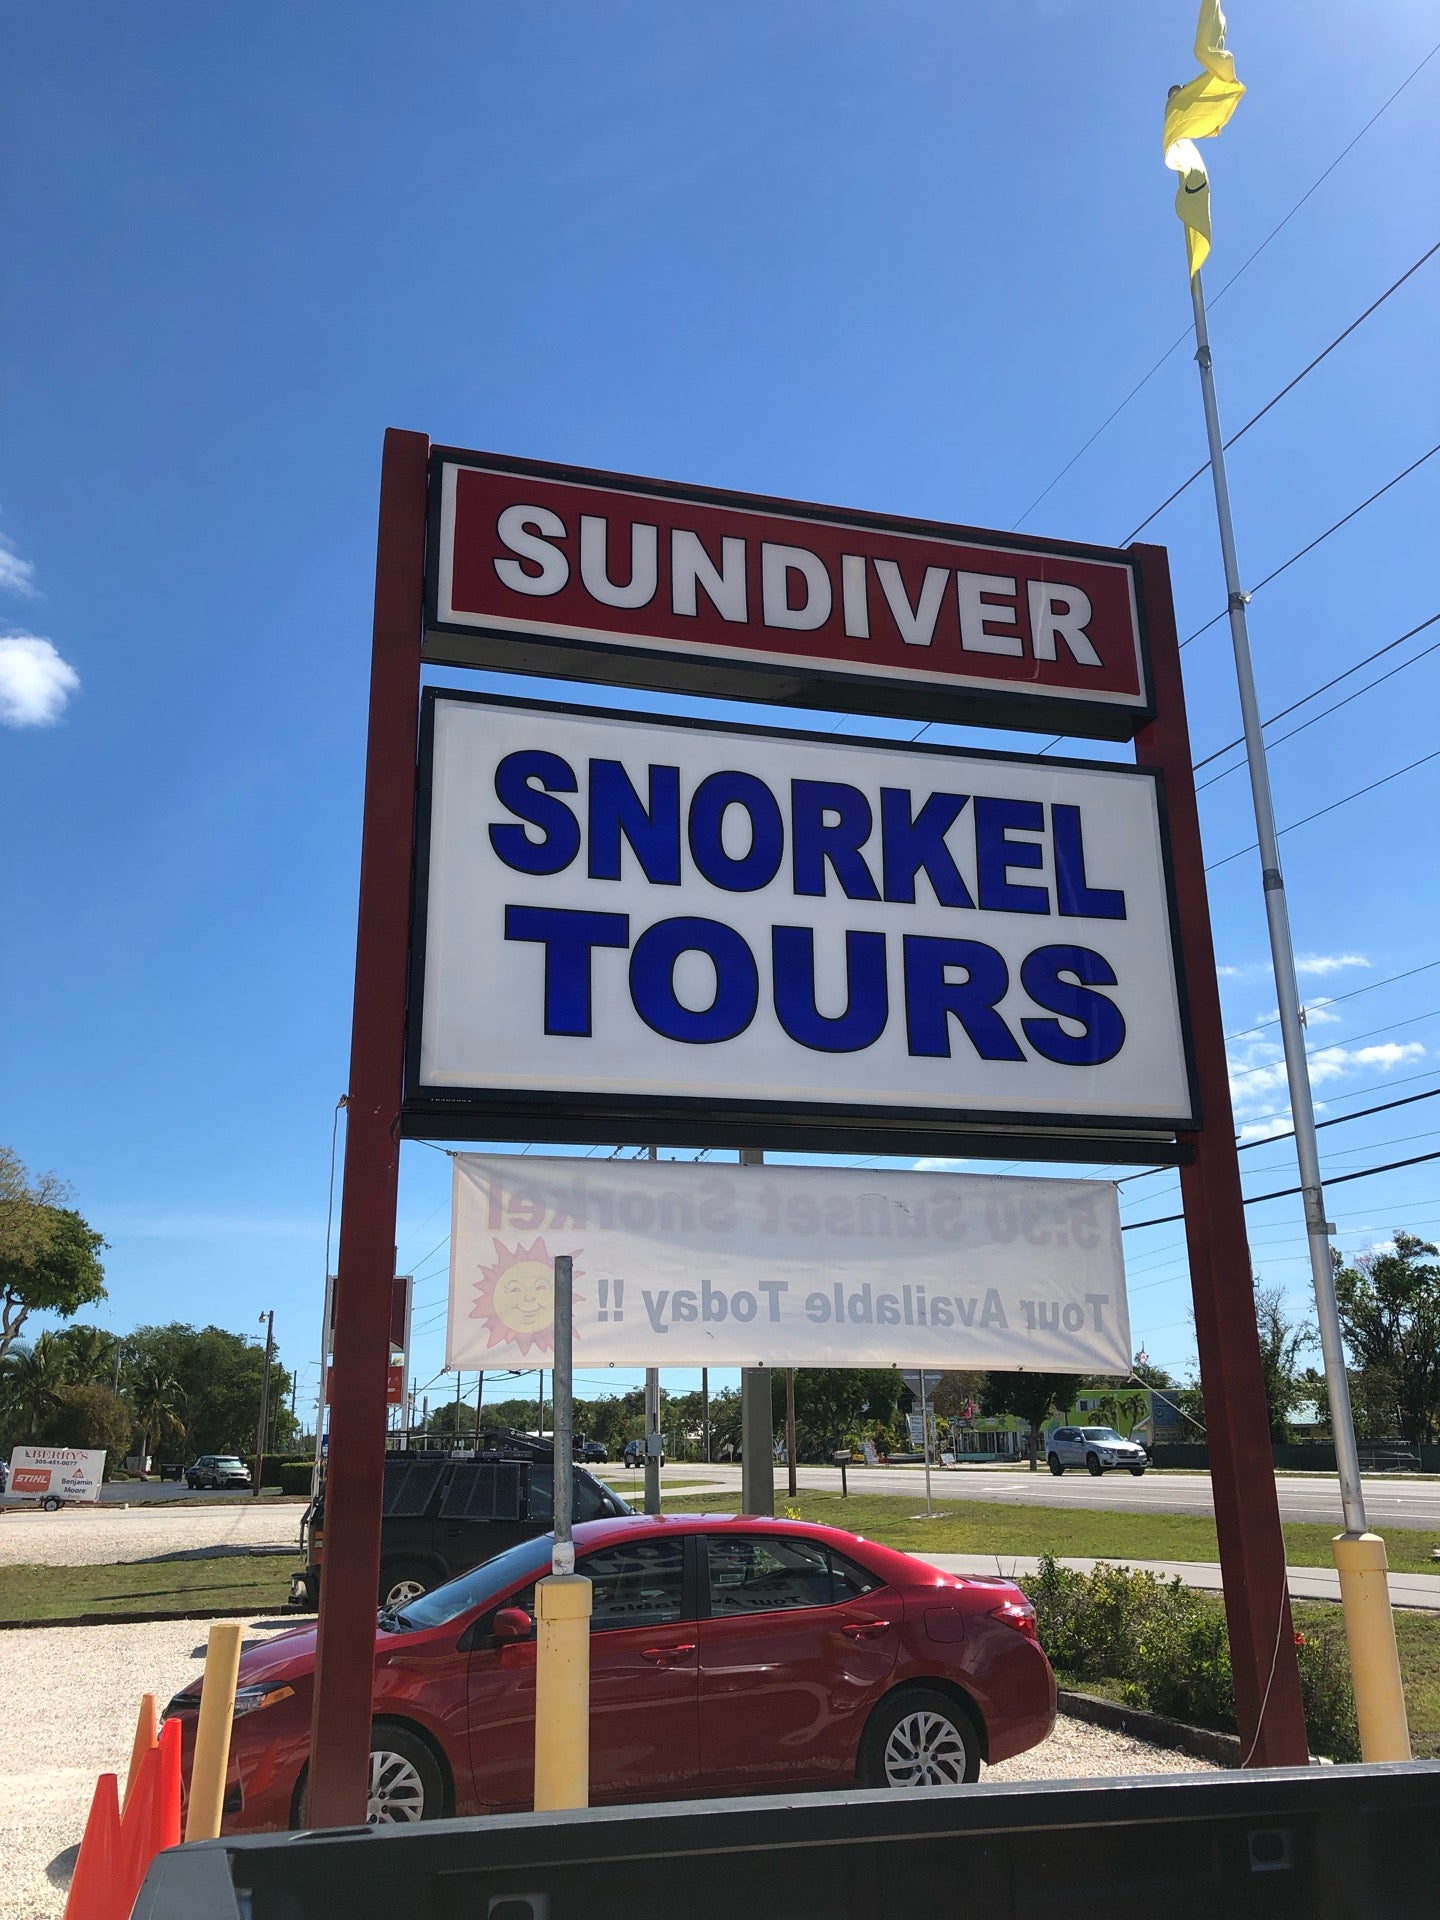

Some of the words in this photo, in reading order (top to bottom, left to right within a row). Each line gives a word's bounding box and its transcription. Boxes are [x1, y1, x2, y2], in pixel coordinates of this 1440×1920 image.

[493, 503, 1104, 668] SUNDIVER
[489, 750, 1126, 920] SNORKEL
[504, 904, 1126, 1067] TOURS
[15, 1474, 47, 1483] STIHL
[61, 1478, 92, 1486] Benjamin
